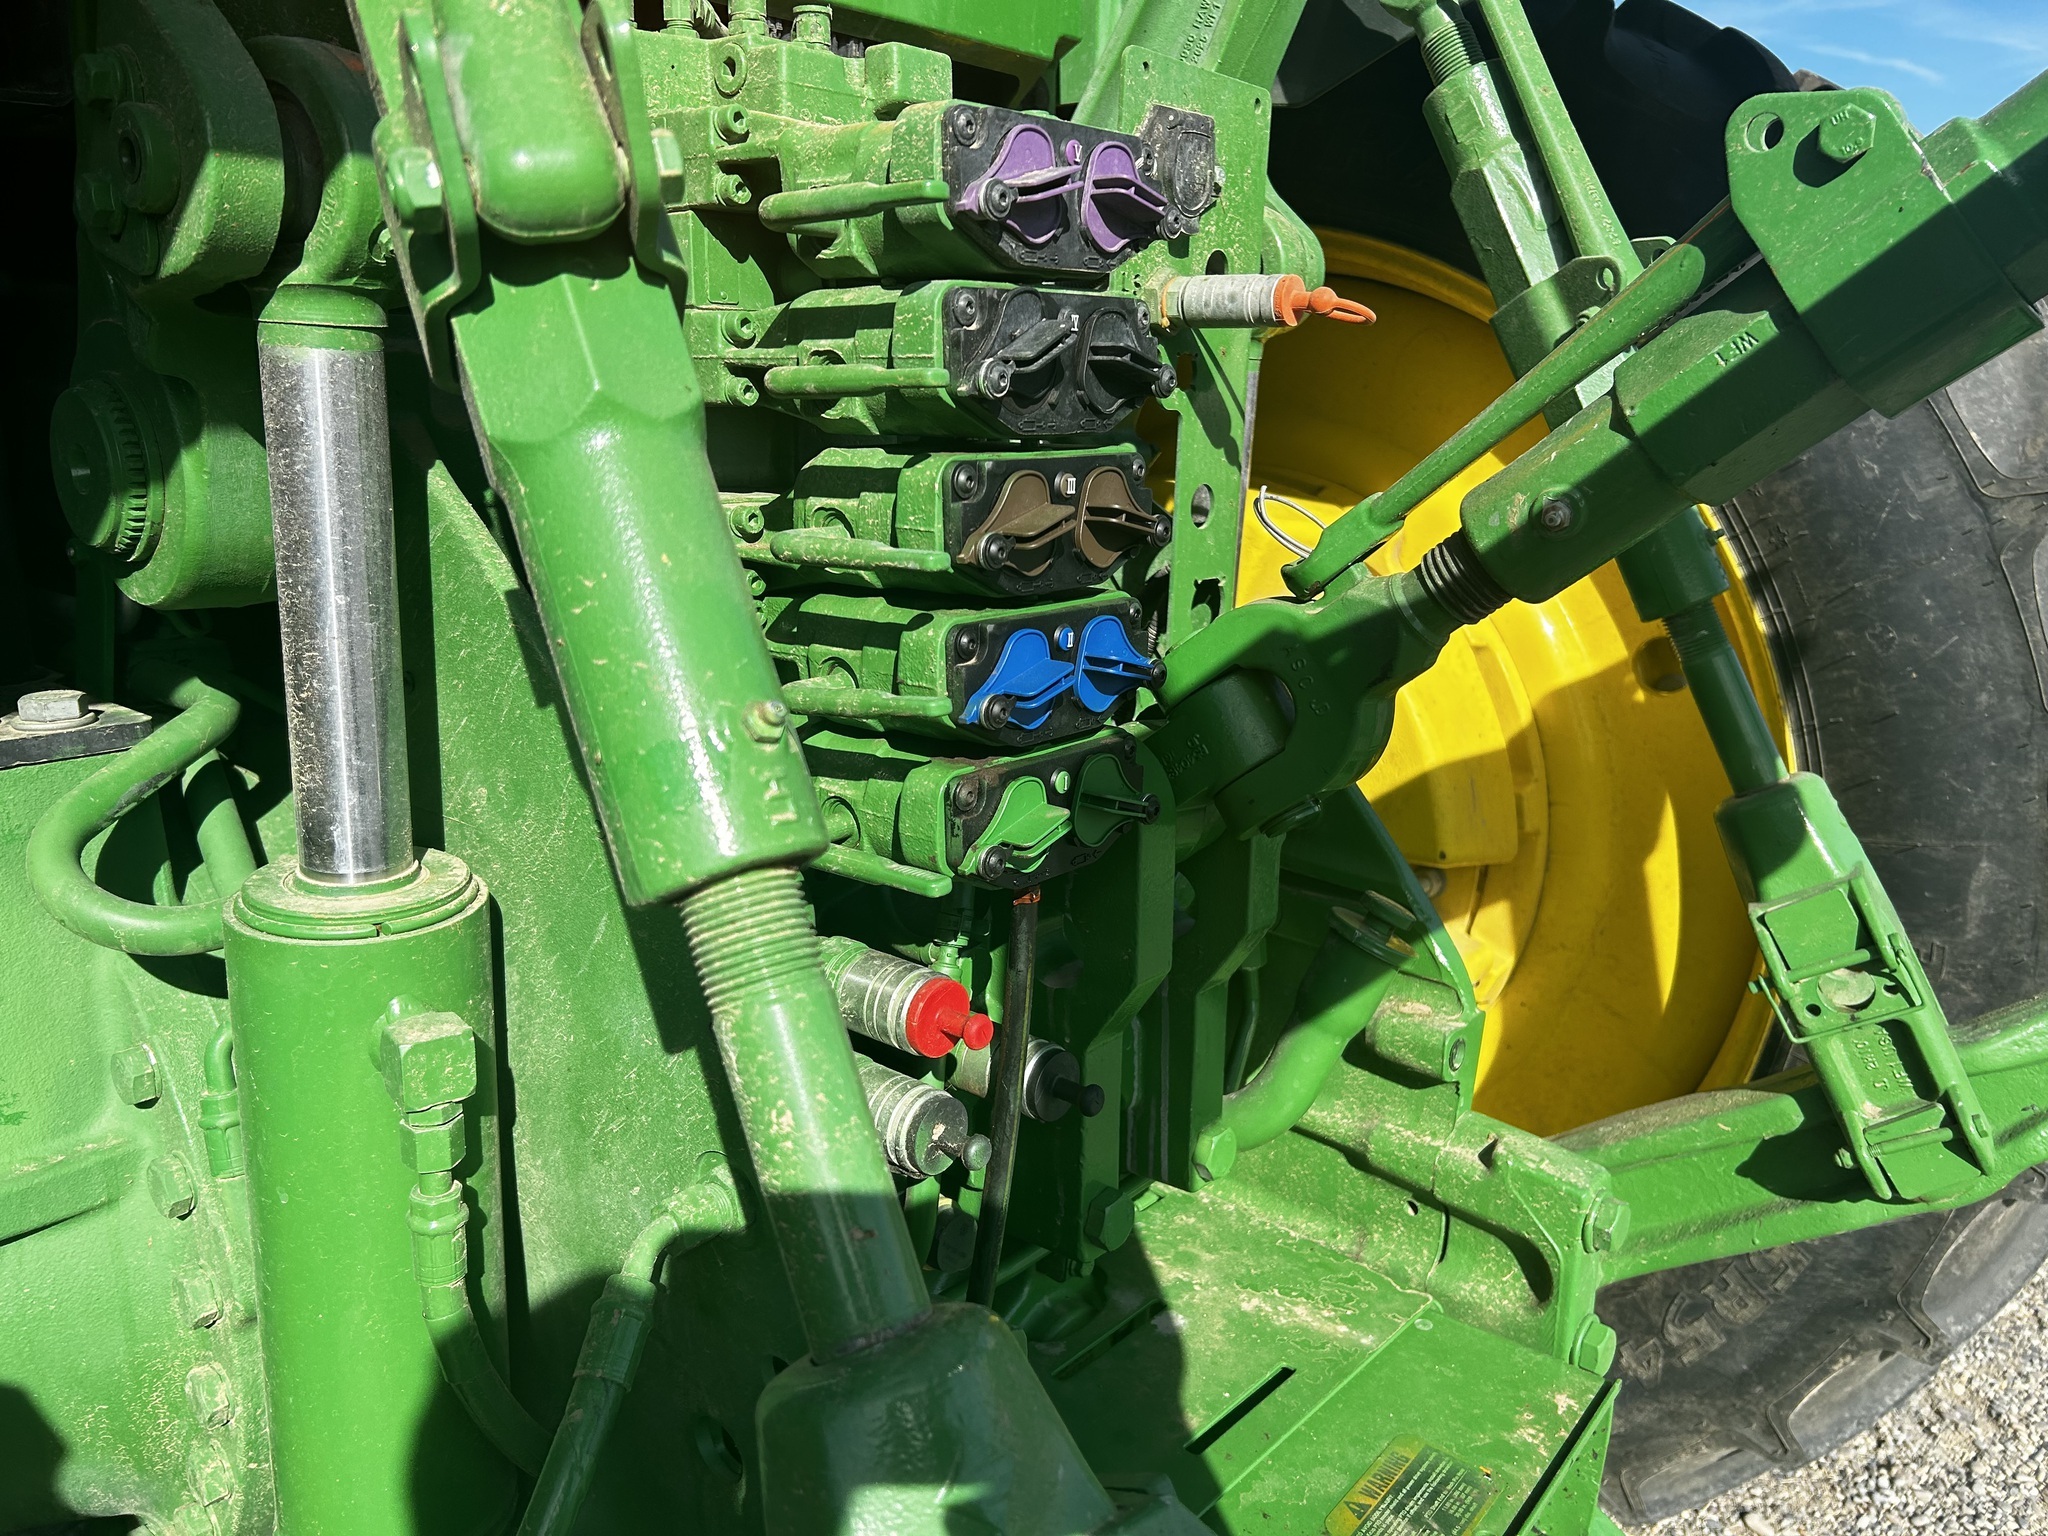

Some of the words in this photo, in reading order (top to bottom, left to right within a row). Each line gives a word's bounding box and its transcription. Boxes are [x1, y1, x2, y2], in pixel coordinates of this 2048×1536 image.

[1073, 144, 1083, 162] V
[1066, 477, 1077, 495] III
[1066, 631, 1074, 648] II
[1063, 775, 1069, 791] I
[1358, 1451, 1411, 1500] WARNING
